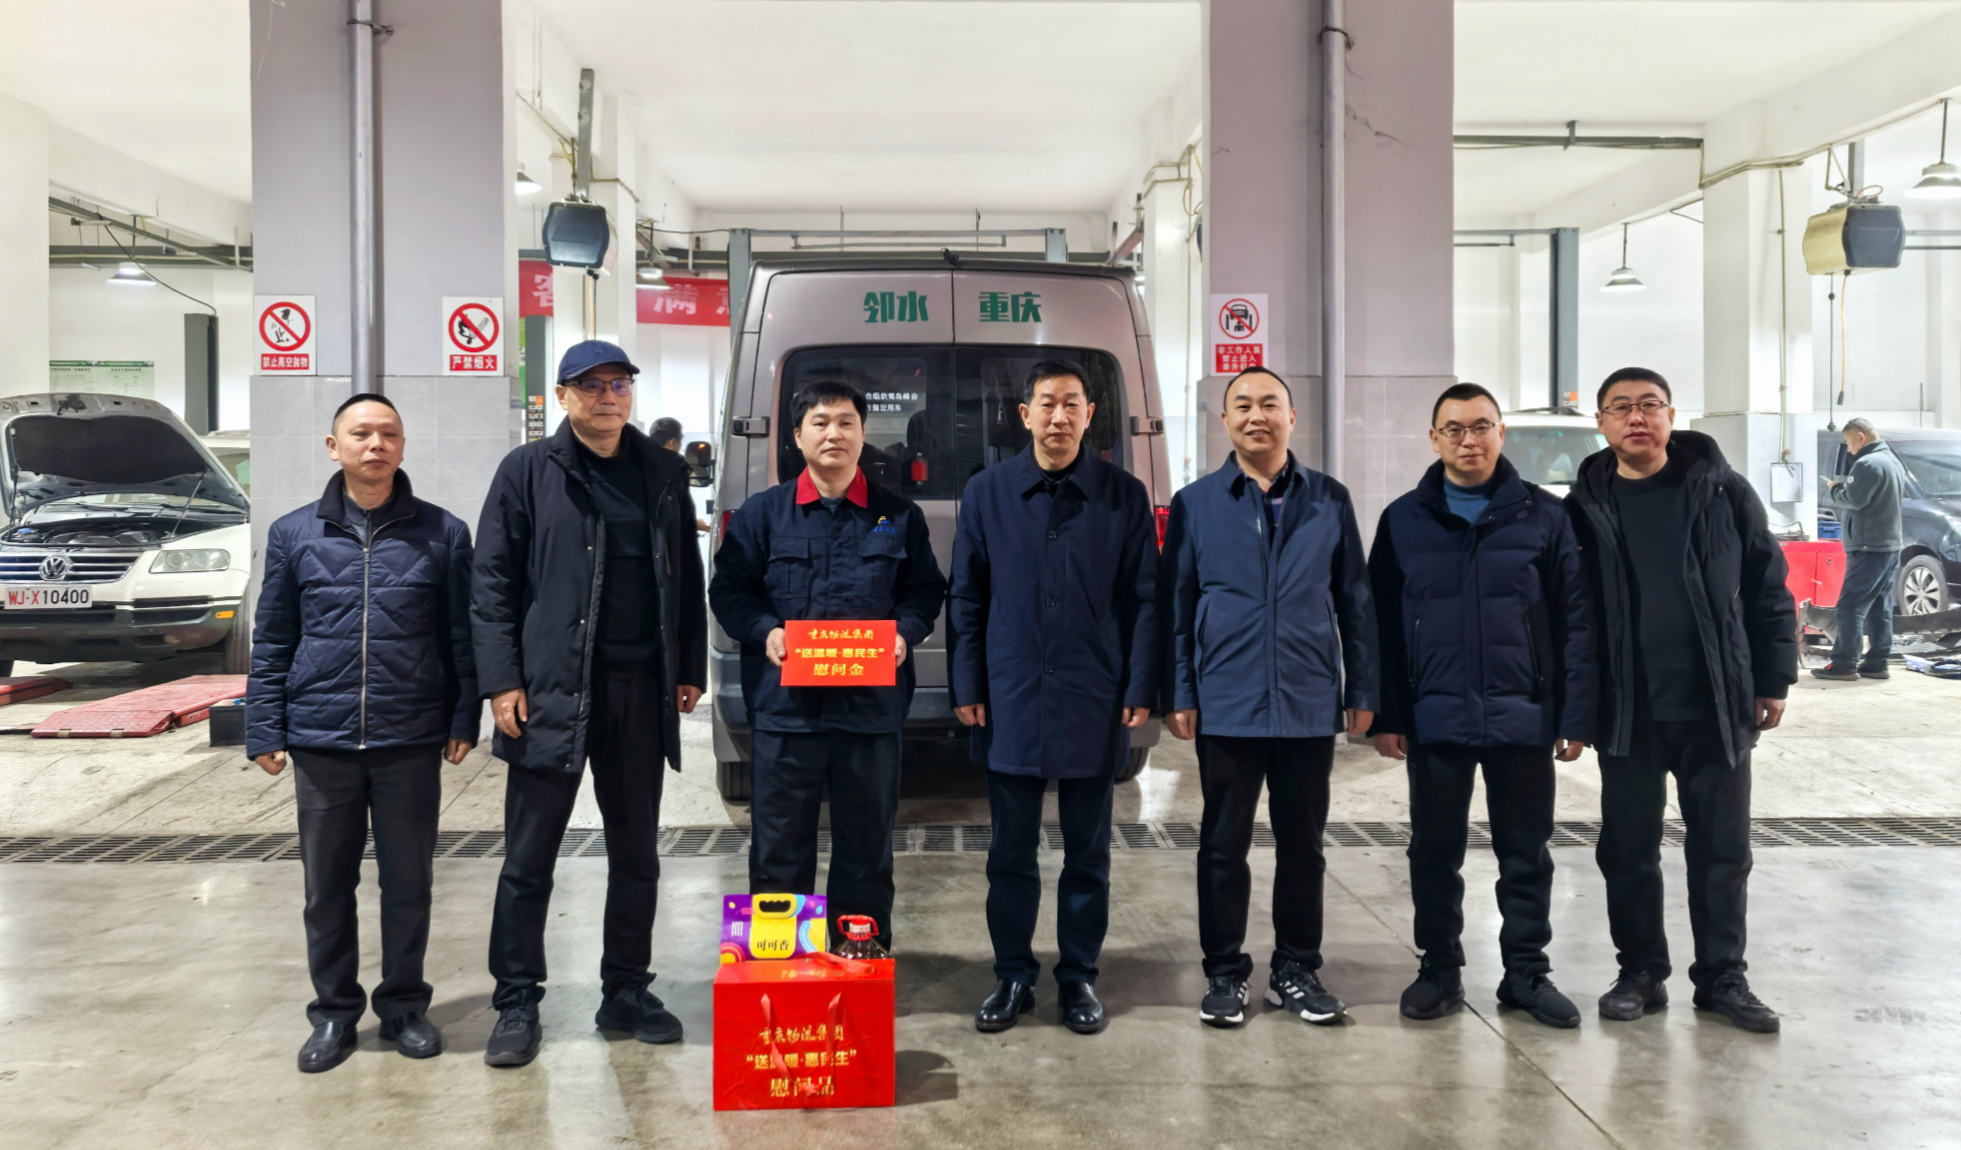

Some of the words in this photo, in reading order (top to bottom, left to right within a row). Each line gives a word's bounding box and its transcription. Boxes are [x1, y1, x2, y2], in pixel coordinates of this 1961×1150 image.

[863, 291, 929, 323] 邻水
[978, 291, 1042, 323] 重庆
[452, 356, 494, 369] 严禁烟火
[808, 628, 874, 640] 重庆物流集团
[813, 663, 864, 676] 慰问金
